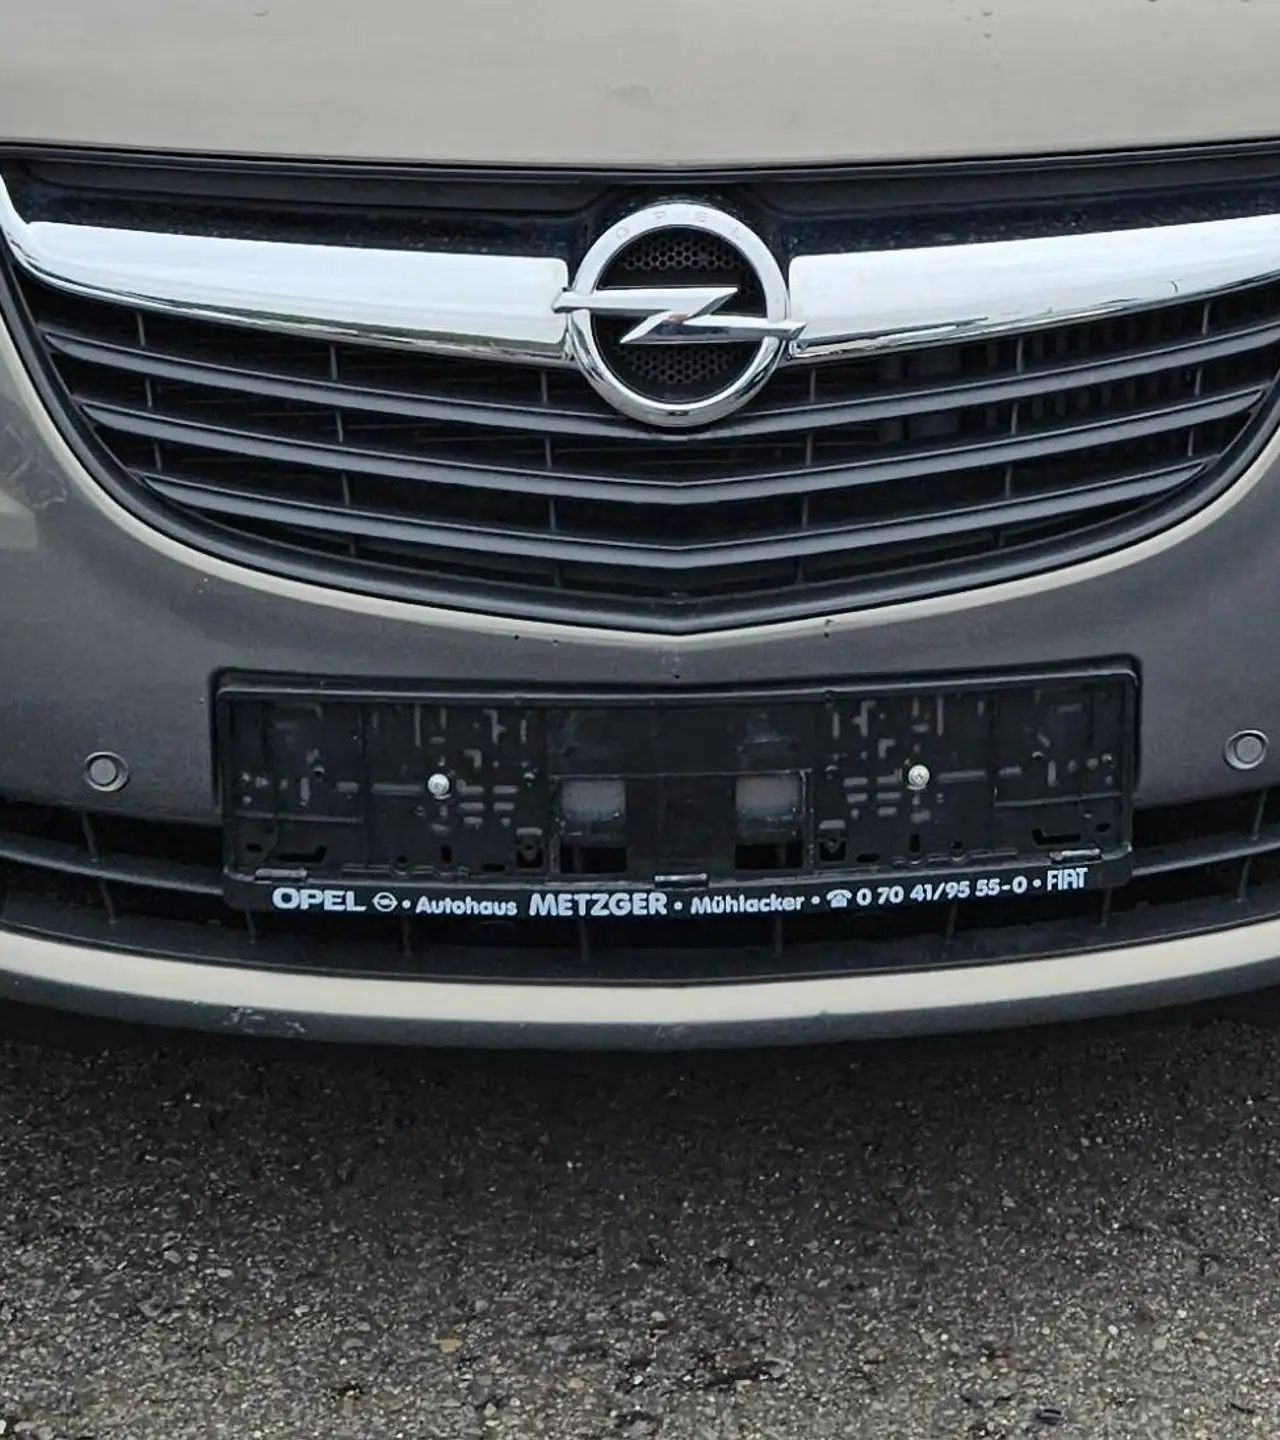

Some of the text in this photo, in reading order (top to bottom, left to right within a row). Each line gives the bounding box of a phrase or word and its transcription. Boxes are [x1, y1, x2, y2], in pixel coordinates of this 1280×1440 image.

[271, 887, 367, 912] OPEL
[414, 895, 518, 917] Autohaus
[528, 892, 668, 917] METZGER
[690, 891, 806, 915] Mühlacker
[909, 880, 971, 902] 41/95
[974, 875, 1028, 897] 55-0
[1045, 867, 1090, 892] FIAT
